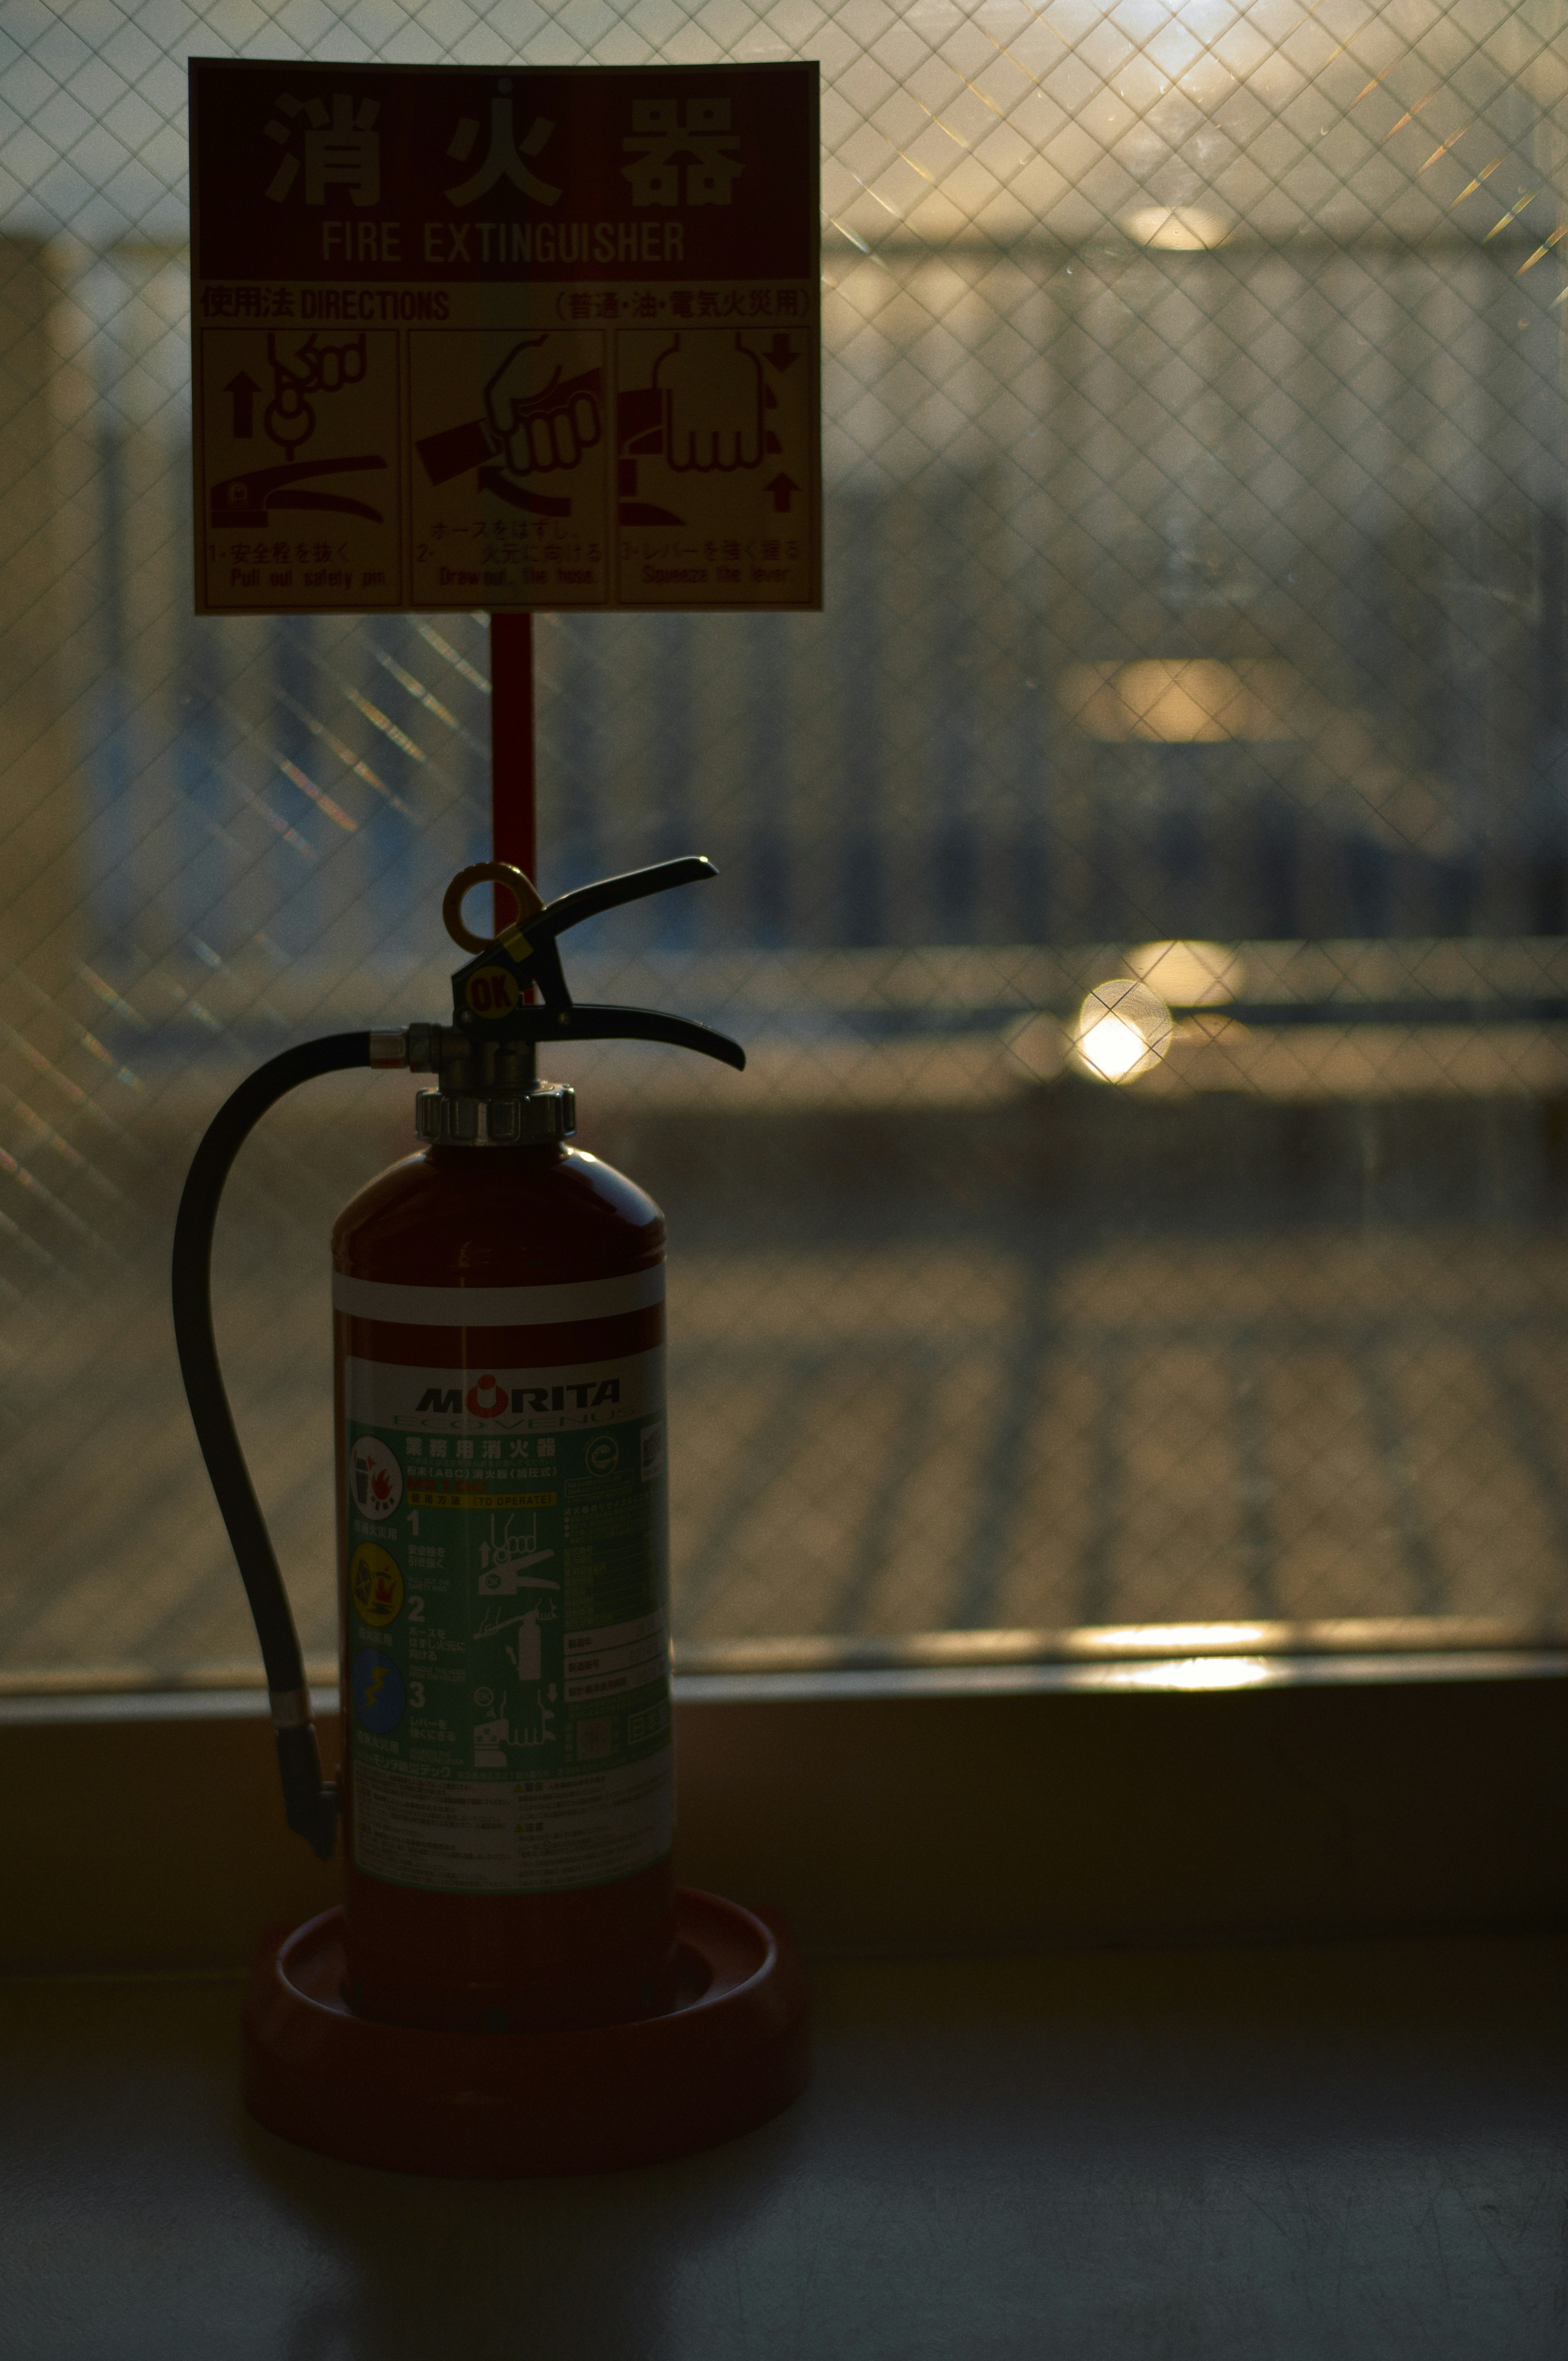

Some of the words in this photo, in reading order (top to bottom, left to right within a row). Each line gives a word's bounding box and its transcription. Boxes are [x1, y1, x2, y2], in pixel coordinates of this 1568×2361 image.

[262, 92, 746, 208] 消火器
[322, 221, 402, 262] FIRE
[423, 221, 685, 263] EXTINGUISHER
[200, 286, 295, 318] 使用法
[301, 289, 450, 321] DIRECTIONS
[231, 568, 260, 587] Pull
[270, 569, 293, 587] out
[304, 568, 353, 590] safety
[439, 566, 480, 586] Draw
[642, 564, 708, 587] Squeeze
[471, 975, 512, 1011] OK
[415, 1374, 620, 1418] MORITA
[394, 1405, 636, 1430] ECOVENUS
[405, 1437, 556, 1459] 業務用消火器
[412, 1493, 461, 1505] 使用方法
[474, 1497, 492, 1506] (TO
[497, 1494, 552, 1506] OPERATE)
[406, 1509, 419, 1536] 1
[408, 1595, 425, 1623] 2
[409, 1626, 445, 1639] ホースを
[409, 1638, 466, 1652] はずし火元に
[409, 1649, 437, 1661] 向ける
[409, 1681, 425, 1708] 3
[477, 1692, 490, 1700] OK
[410, 1716, 447, 1729] レバーを
